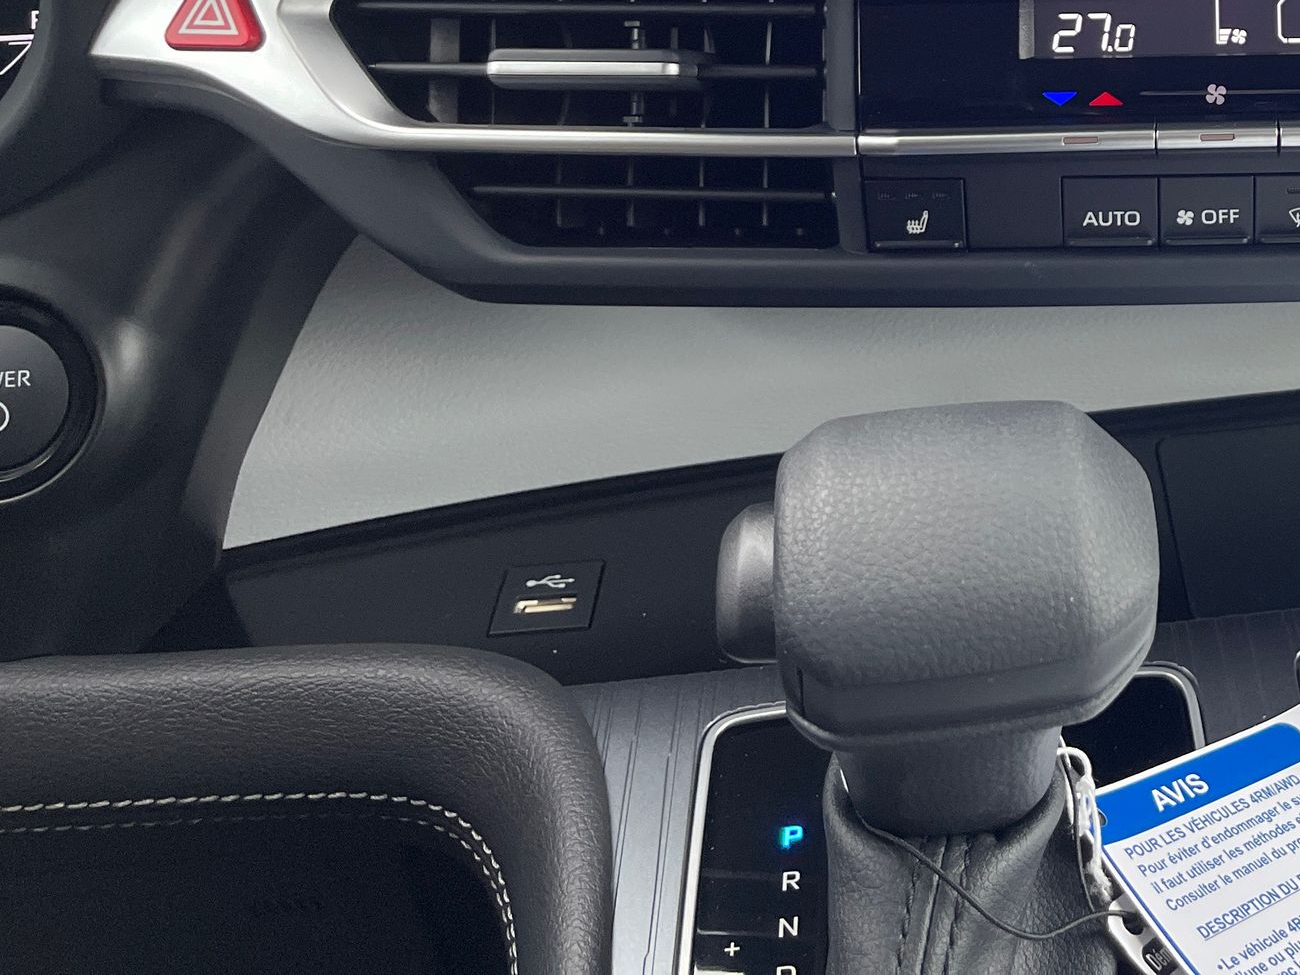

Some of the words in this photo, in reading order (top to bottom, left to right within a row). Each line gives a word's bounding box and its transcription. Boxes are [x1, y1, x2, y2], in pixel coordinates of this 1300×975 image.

[1052, 12, 1136, 54] 27.0
[1082, 210, 1141, 226] AUTO
[1201, 209, 1240, 225] OFF
[1151, 773, 1210, 813] AVIS
[779, 824, 804, 850] P
[1123, 837, 1163, 860] POUR
[1158, 826, 1187, 846] LES
[1182, 798, 1251, 834] VÉHICULES
[1249, 774, 1300, 804] 4RM/AWD
[1137, 858, 1168, 877] Pour
[1167, 843, 1201, 865] éviter
[1201, 806, 1281, 849] d'endommager
[1276, 801, 1292, 812] le
[1150, 881, 1164, 894] il
[1160, 871, 1188, 890] faut
[1185, 854, 1226, 879] utiliser
[1222, 846, 1244, 860] les
[1242, 820, 1297, 852] méthodes
[782, 871, 800, 891] R
[1165, 879, 1221, 911] Consulter
[1217, 874, 1233, 886] le
[1231, 851, 1273, 880] manuel
[1271, 846, 1288, 860] du
[778, 916, 799, 938] N
[1196, 888, 1284, 941] DESCRIPTION
